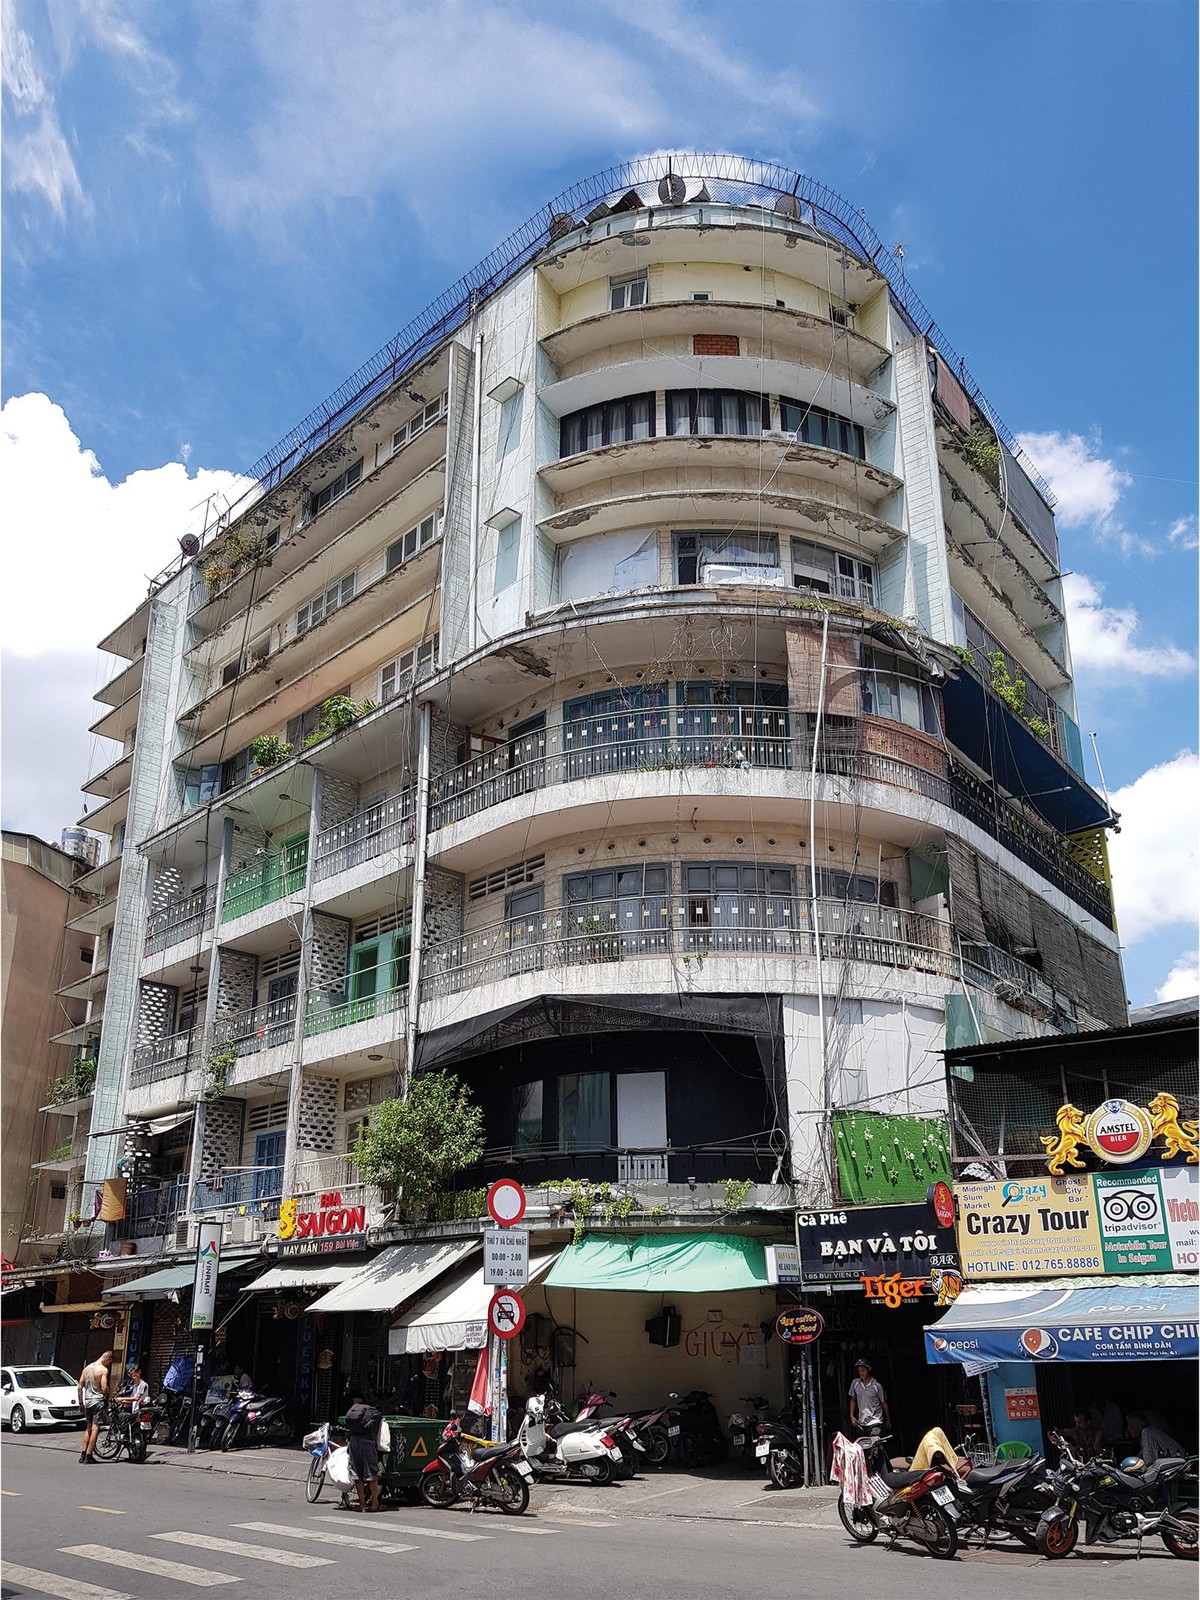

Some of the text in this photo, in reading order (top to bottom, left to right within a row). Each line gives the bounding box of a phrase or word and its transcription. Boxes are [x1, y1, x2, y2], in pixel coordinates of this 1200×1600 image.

[1100, 1123, 1136, 1134] AMSTEL
[1056, 1178, 1081, 1186] Ghost
[1096, 1175, 1158, 1186] Recommended
[962, 1185, 996, 1193] Midnight
[320, 1192, 342, 1208] BIA
[964, 1202, 991, 1210] Market
[297, 1205, 366, 1238] SAIGON
[798, 1212, 848, 1226] Cà Phê
[966, 1208, 1089, 1236] Crazy Tour
[1104, 1223, 1158, 1233] tripadvisor
[283, 1245, 299, 1256] MAY
[320, 1242, 334, 1252] 159
[820, 1230, 938, 1260] BẠN VÀ TÔI
[1104, 1240, 1167, 1252] Motorbike Tour
[929, 1254, 957, 1266] BAR
[1128, 1253, 1156, 1265] Saigon
[1176, 1252, 1199, 1264] HO
[967, 1257, 1100, 1272] HOTLINE: 012.765.88886
[490, 1268, 503, 1276] 19:00
[509, 1268, 523, 1276] 24:00
[860, 1272, 927, 1308] Tiger
[1088, 1303, 1168, 1314] pepsi
[1058, 1328, 1102, 1342] CAFE
[1108, 1326, 1154, 1340] CHIP
[950, 1339, 979, 1350] pepsi
